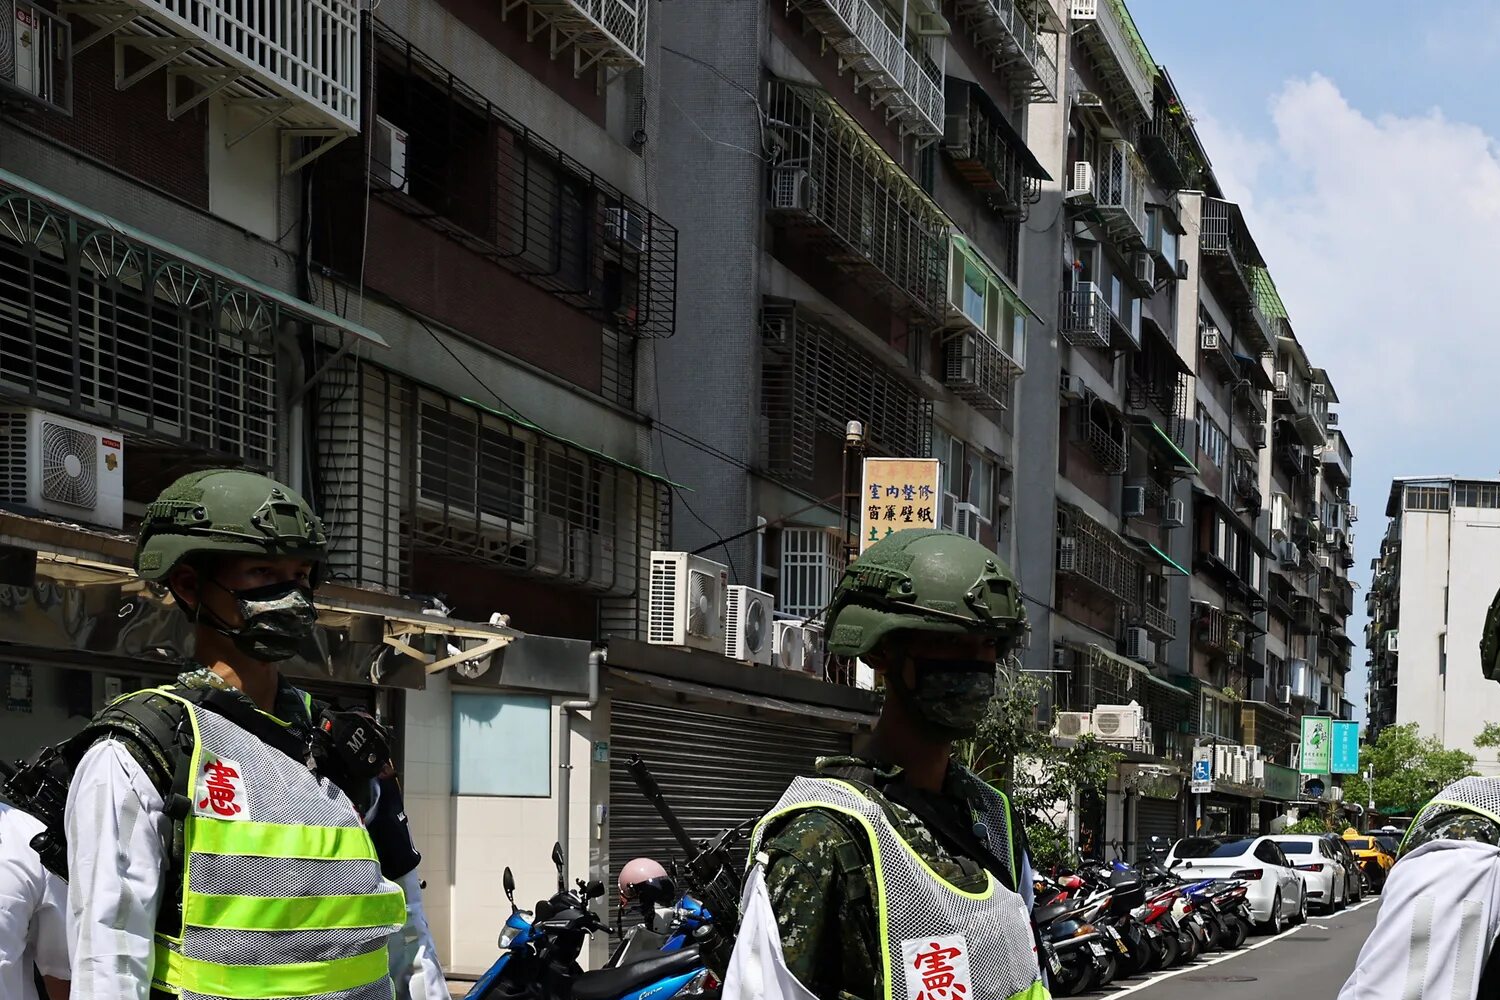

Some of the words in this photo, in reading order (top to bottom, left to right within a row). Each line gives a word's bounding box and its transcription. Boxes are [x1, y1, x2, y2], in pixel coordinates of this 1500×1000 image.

[869, 483, 934, 501] 室內整修
[868, 504, 934, 523] 窗簾壁紙
[346, 727, 367, 754] MP
[199, 758, 242, 817] 憲
